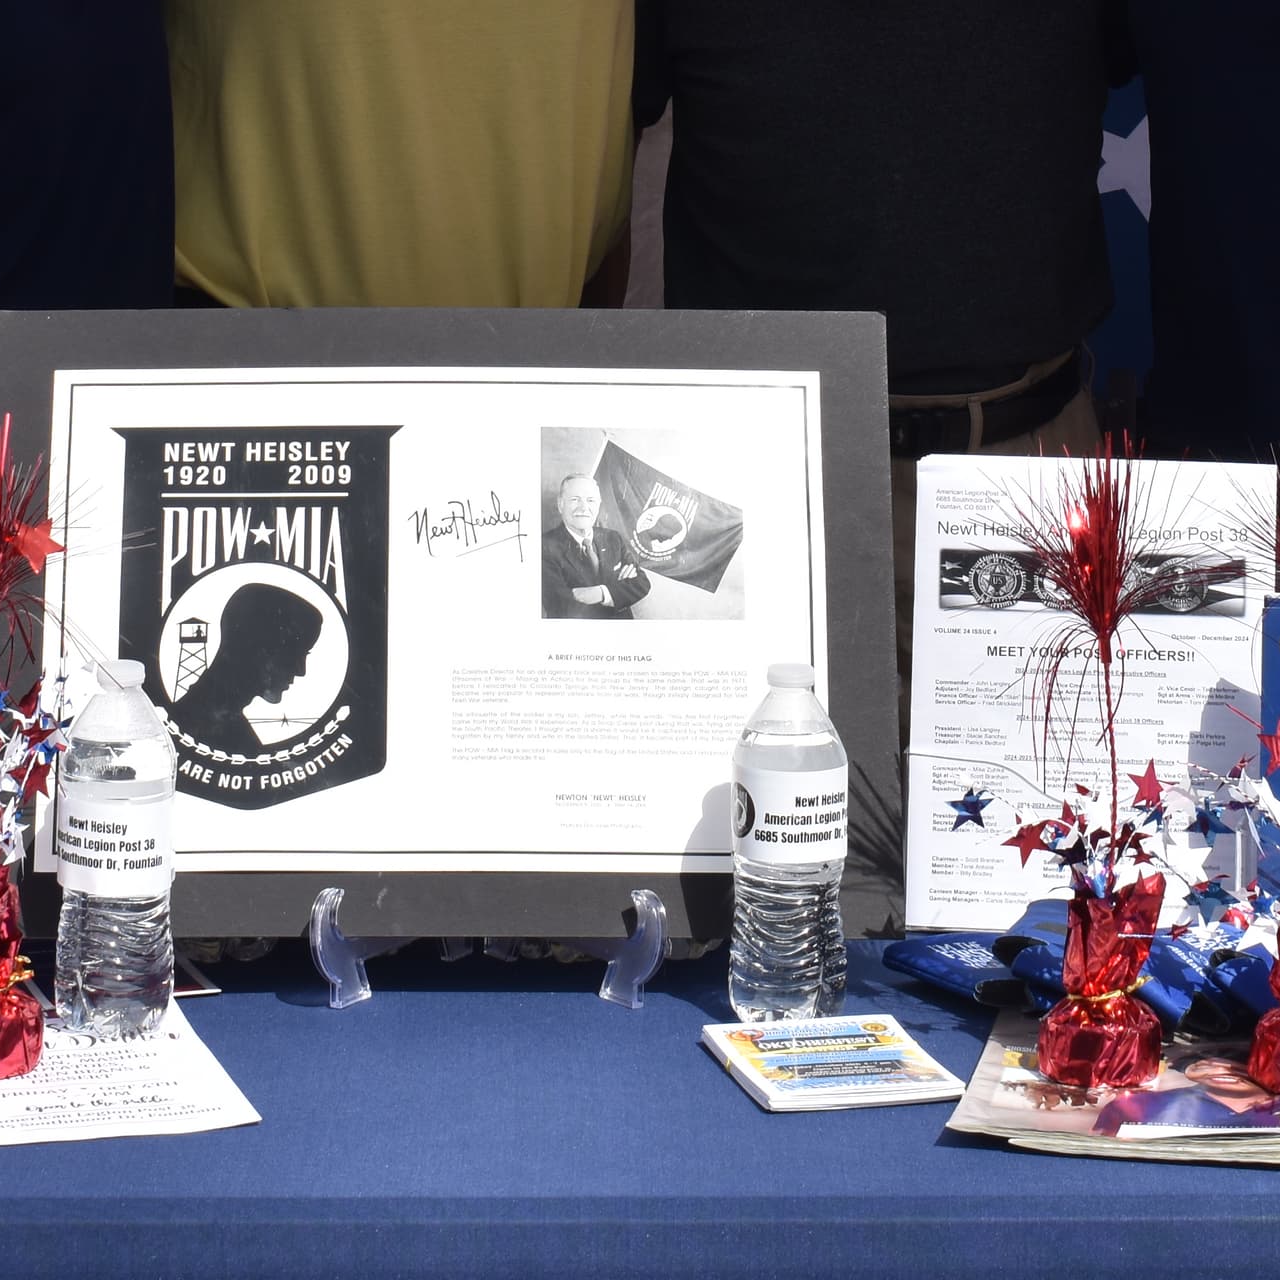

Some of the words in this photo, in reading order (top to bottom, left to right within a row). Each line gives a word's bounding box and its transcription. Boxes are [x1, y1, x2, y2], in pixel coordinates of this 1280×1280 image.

[164, 442, 236, 463] NEWT
[246, 441, 351, 462] HEISLEY
[163, 465, 226, 486] 1920
[288, 464, 352, 485] 2009
[937, 521, 977, 537] Newt
[983, 521, 1041, 542] Heisley
[1188, 527, 1224, 542] Post
[1228, 527, 1248, 543] 38
[161, 507, 252, 618] POW
[275, 507, 348, 616] MIA
[934, 627, 961, 635] VOLUME
[575, 654, 604, 662] HISTORY
[987, 645, 1024, 658] MEET
[1029, 646, 1070, 660] YOUR
[1115, 649, 1196, 663] OFFICERS!!
[179, 759, 214, 784] ARE
[218, 773, 253, 790] NOT
[261, 733, 353, 789] FORGOTTEN
[795, 795, 819, 808] Newt
[69, 816, 88, 831] Newt
[91, 821, 127, 836] Heisley
[764, 813, 812, 826] American
[815, 810, 840, 825] Legion
[84, 837, 116, 852] Legion
[120, 840, 141, 852] Post
[144, 838, 155, 851] 38
[754, 829, 778, 843] 6685
[781, 830, 832, 844] Southmoor
[123, 855, 162, 870] Fountain
